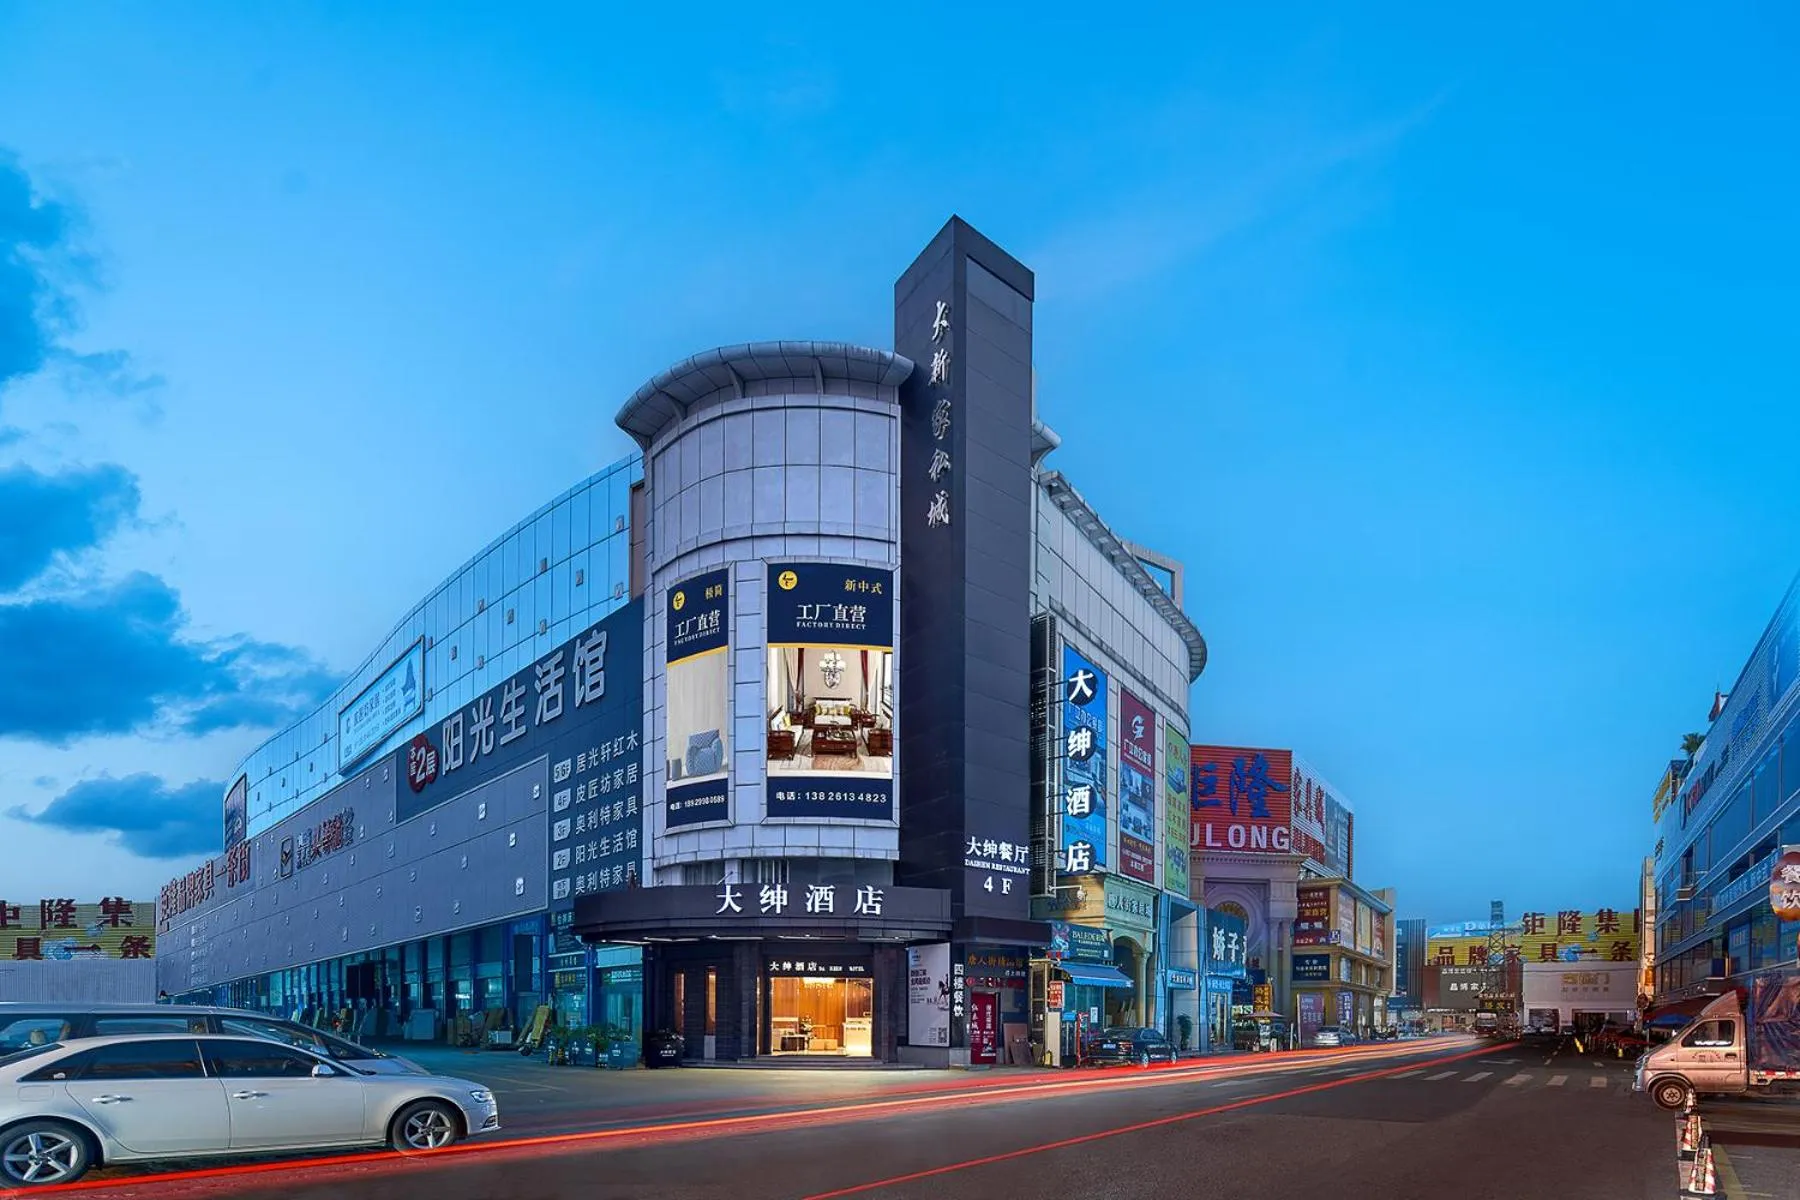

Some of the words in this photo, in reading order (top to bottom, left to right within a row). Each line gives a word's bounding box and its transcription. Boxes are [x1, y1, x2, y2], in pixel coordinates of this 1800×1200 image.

[674, 609, 721, 639] 工厂直营
[796, 604, 867, 623] 工厂直营
[441, 629, 608, 776] 阳光生活馆
[1066, 669, 1094, 872] 大绅酒店
[574, 796, 638, 835] 奥利特家具
[574, 828, 638, 865] 阳光生活馆
[966, 836, 1029, 863] 大绅餐厅
[715, 884, 884, 915] 大绅酒店
